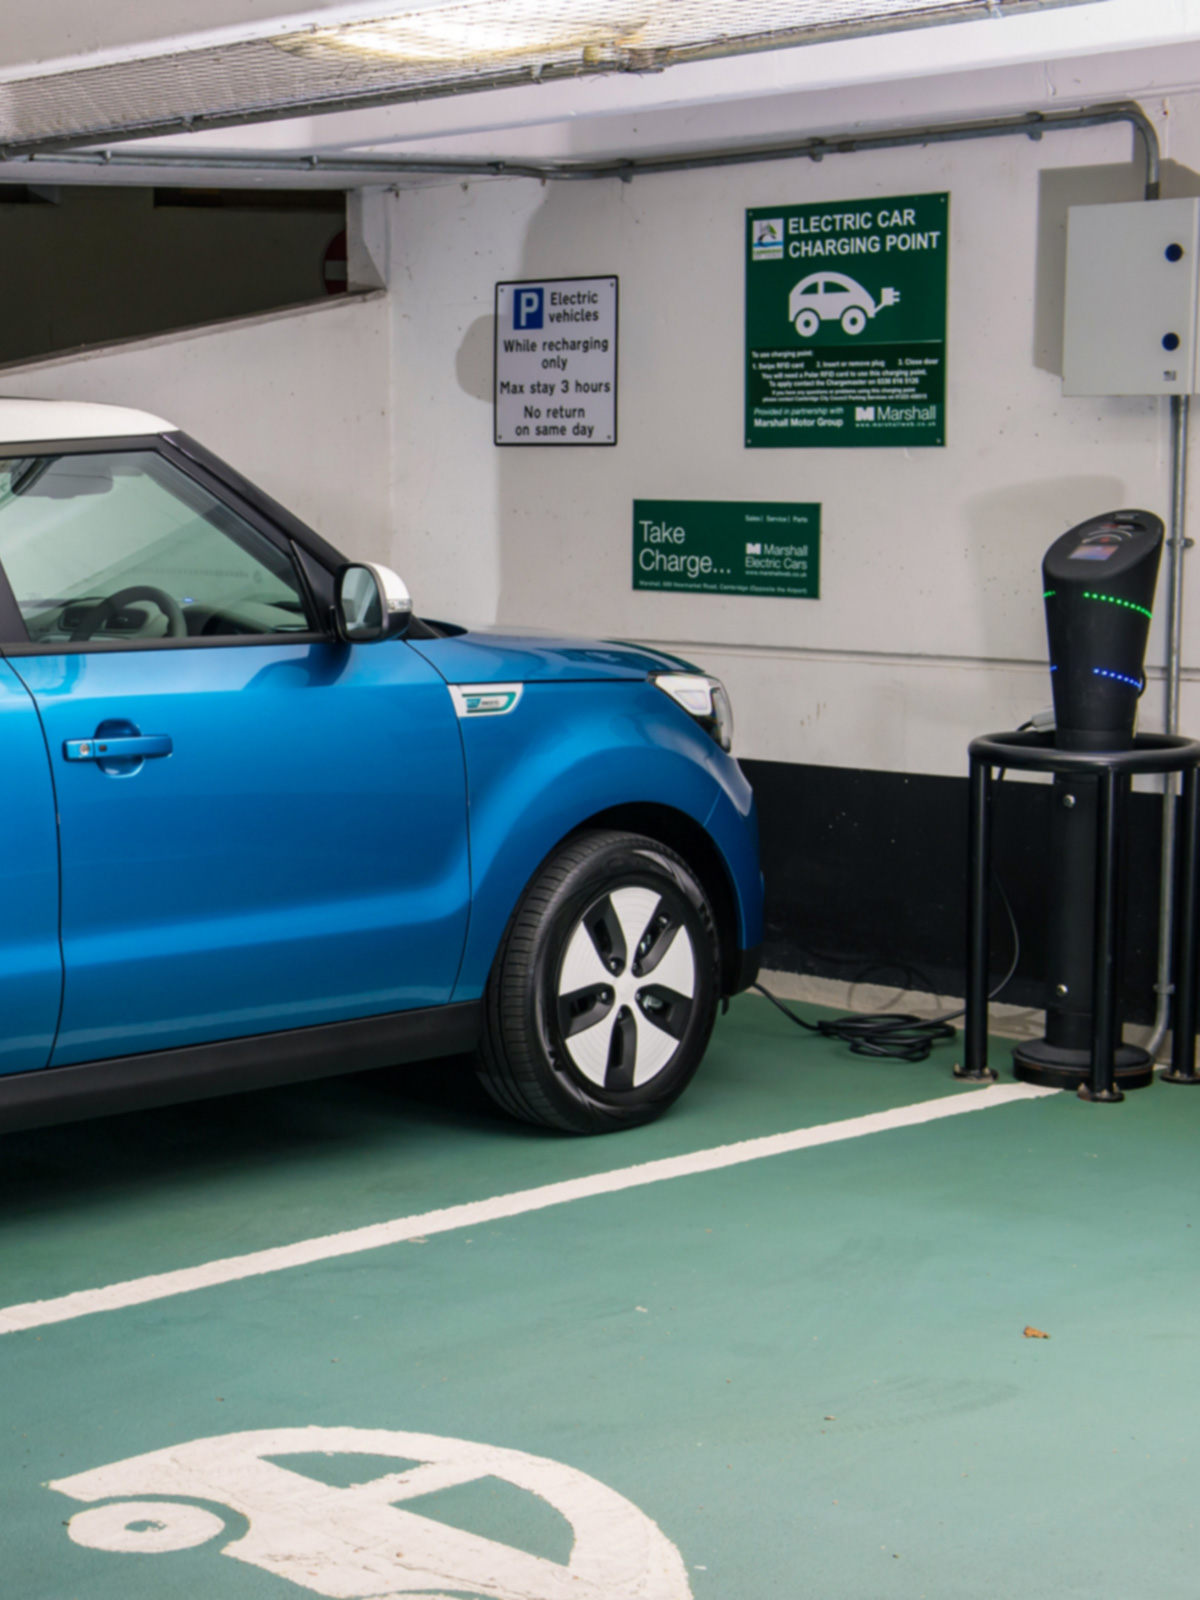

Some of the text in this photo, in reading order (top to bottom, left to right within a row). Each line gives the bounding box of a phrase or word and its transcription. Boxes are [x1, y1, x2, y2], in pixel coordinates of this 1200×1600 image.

[788, 208, 916, 234] ELECTRIC CAR
[788, 236, 880, 258] CHARGING
[886, 232, 940, 251] POINT
[550, 291, 598, 306] Electric
[520, 292, 539, 327] P
[549, 308, 599, 323] vehicles
[503, 337, 609, 353] While recharging
[541, 355, 567, 371] only
[500, 380, 610, 396] Max stay 3 hours
[524, 406, 585, 418] No return
[754, 407, 782, 415] Provided
[790, 407, 828, 416] partnership
[878, 405, 936, 420] Marshall
[515, 422, 594, 438] on same day
[754, 417, 844, 428] Marshall Motor Group
[639, 520, 685, 544] Take
[764, 544, 808, 556] Marshall
[745, 556, 807, 570] Electric Cars
